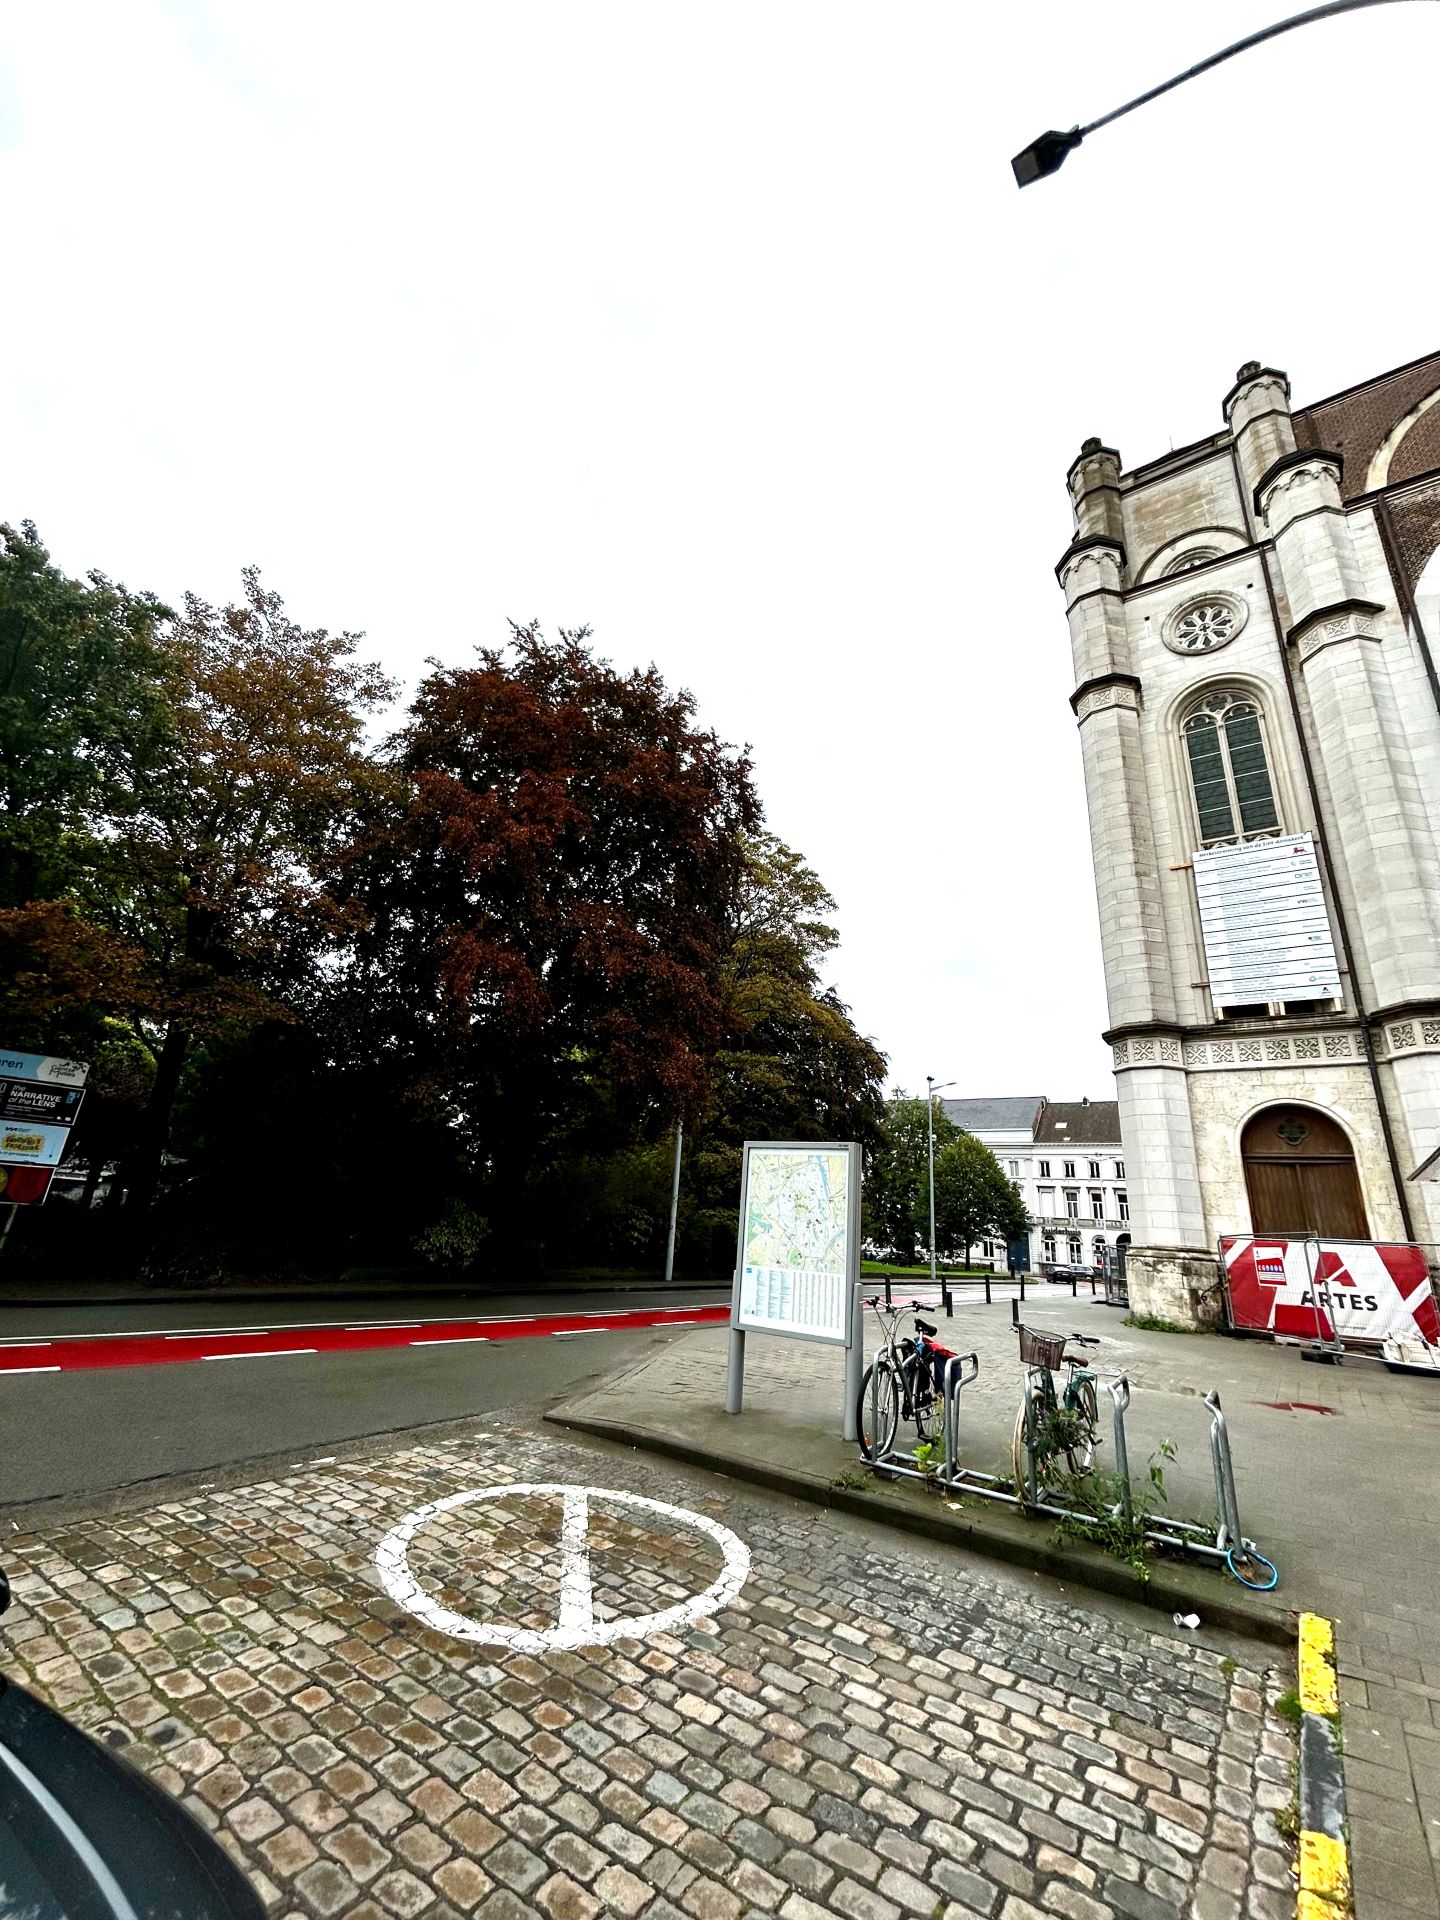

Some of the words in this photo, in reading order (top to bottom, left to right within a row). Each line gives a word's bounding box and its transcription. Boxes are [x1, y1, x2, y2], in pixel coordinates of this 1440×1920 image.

[10, 1091, 62, 1102] NARRATIVE
[32, 1099, 56, 1108] LENS
[1300, 1290, 1378, 1311] ARTES
